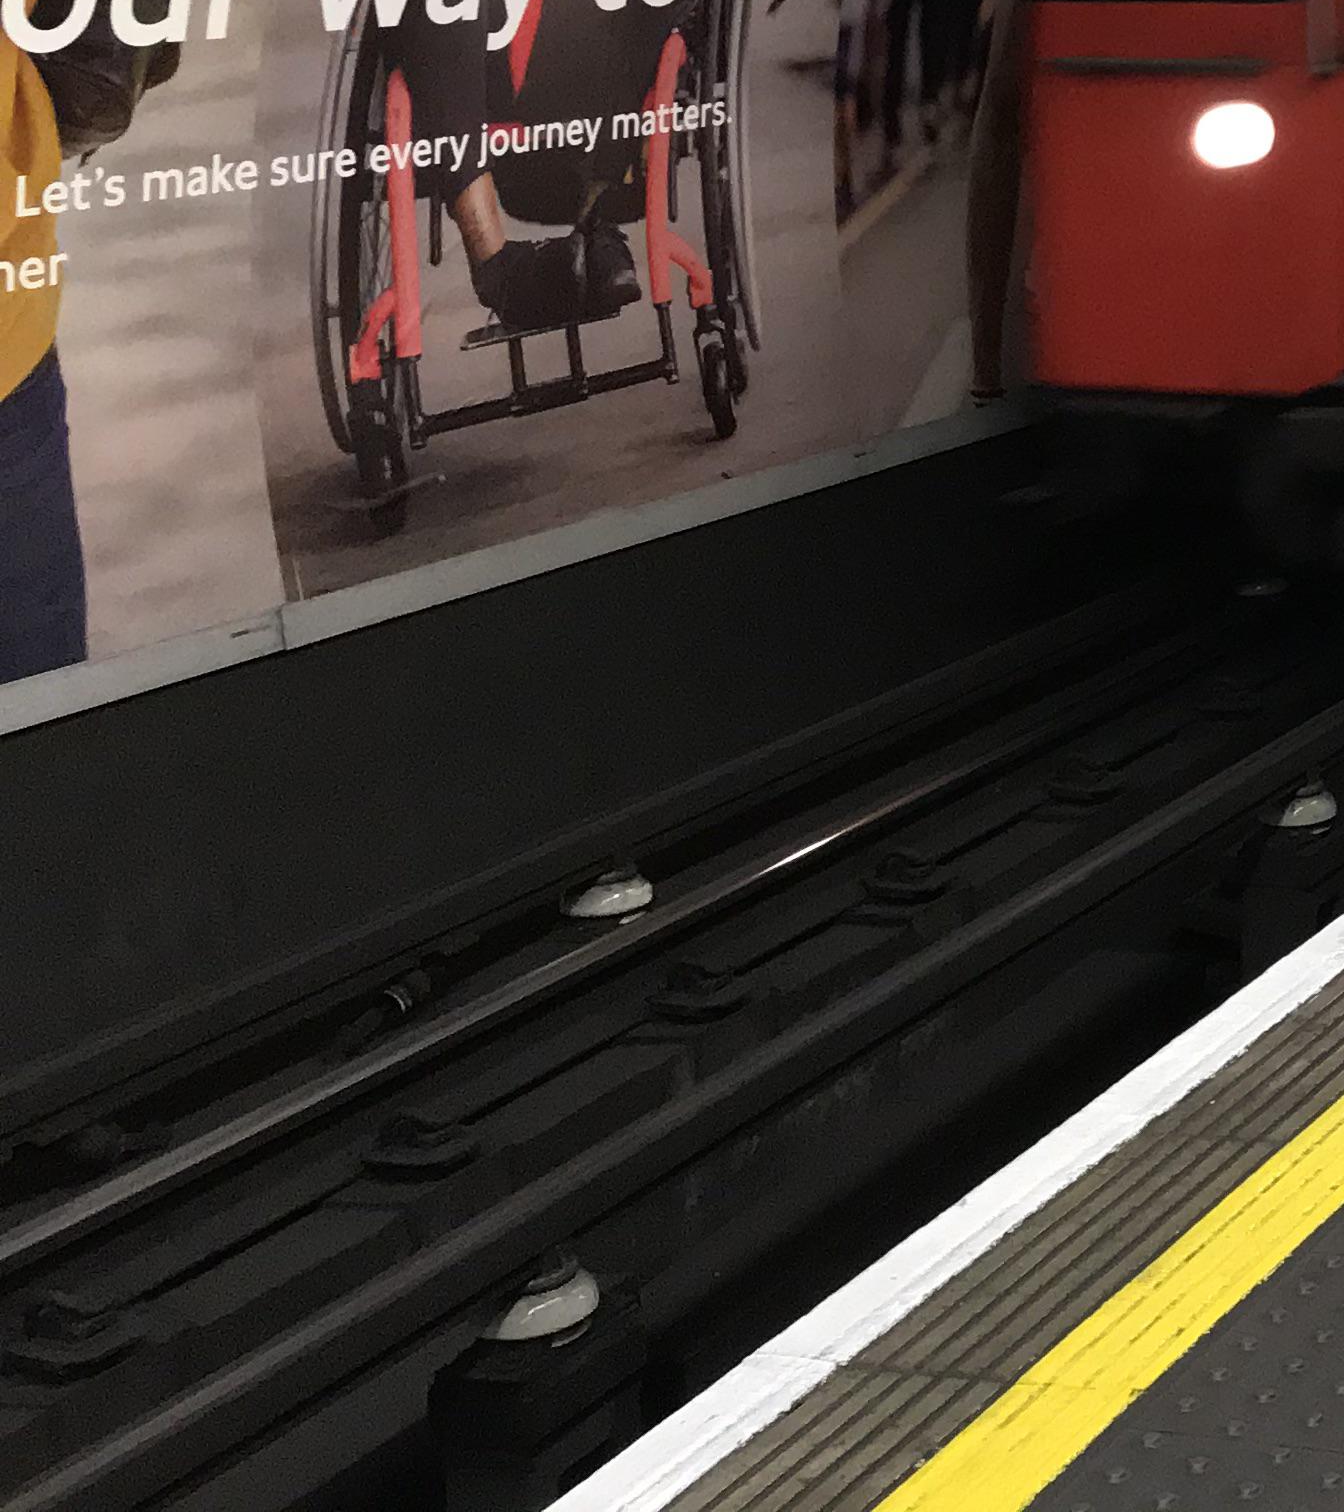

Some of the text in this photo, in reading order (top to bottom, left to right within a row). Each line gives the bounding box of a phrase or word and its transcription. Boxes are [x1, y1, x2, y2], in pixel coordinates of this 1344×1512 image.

[15, 96, 733, 218] Let's make sure every journey matters.
